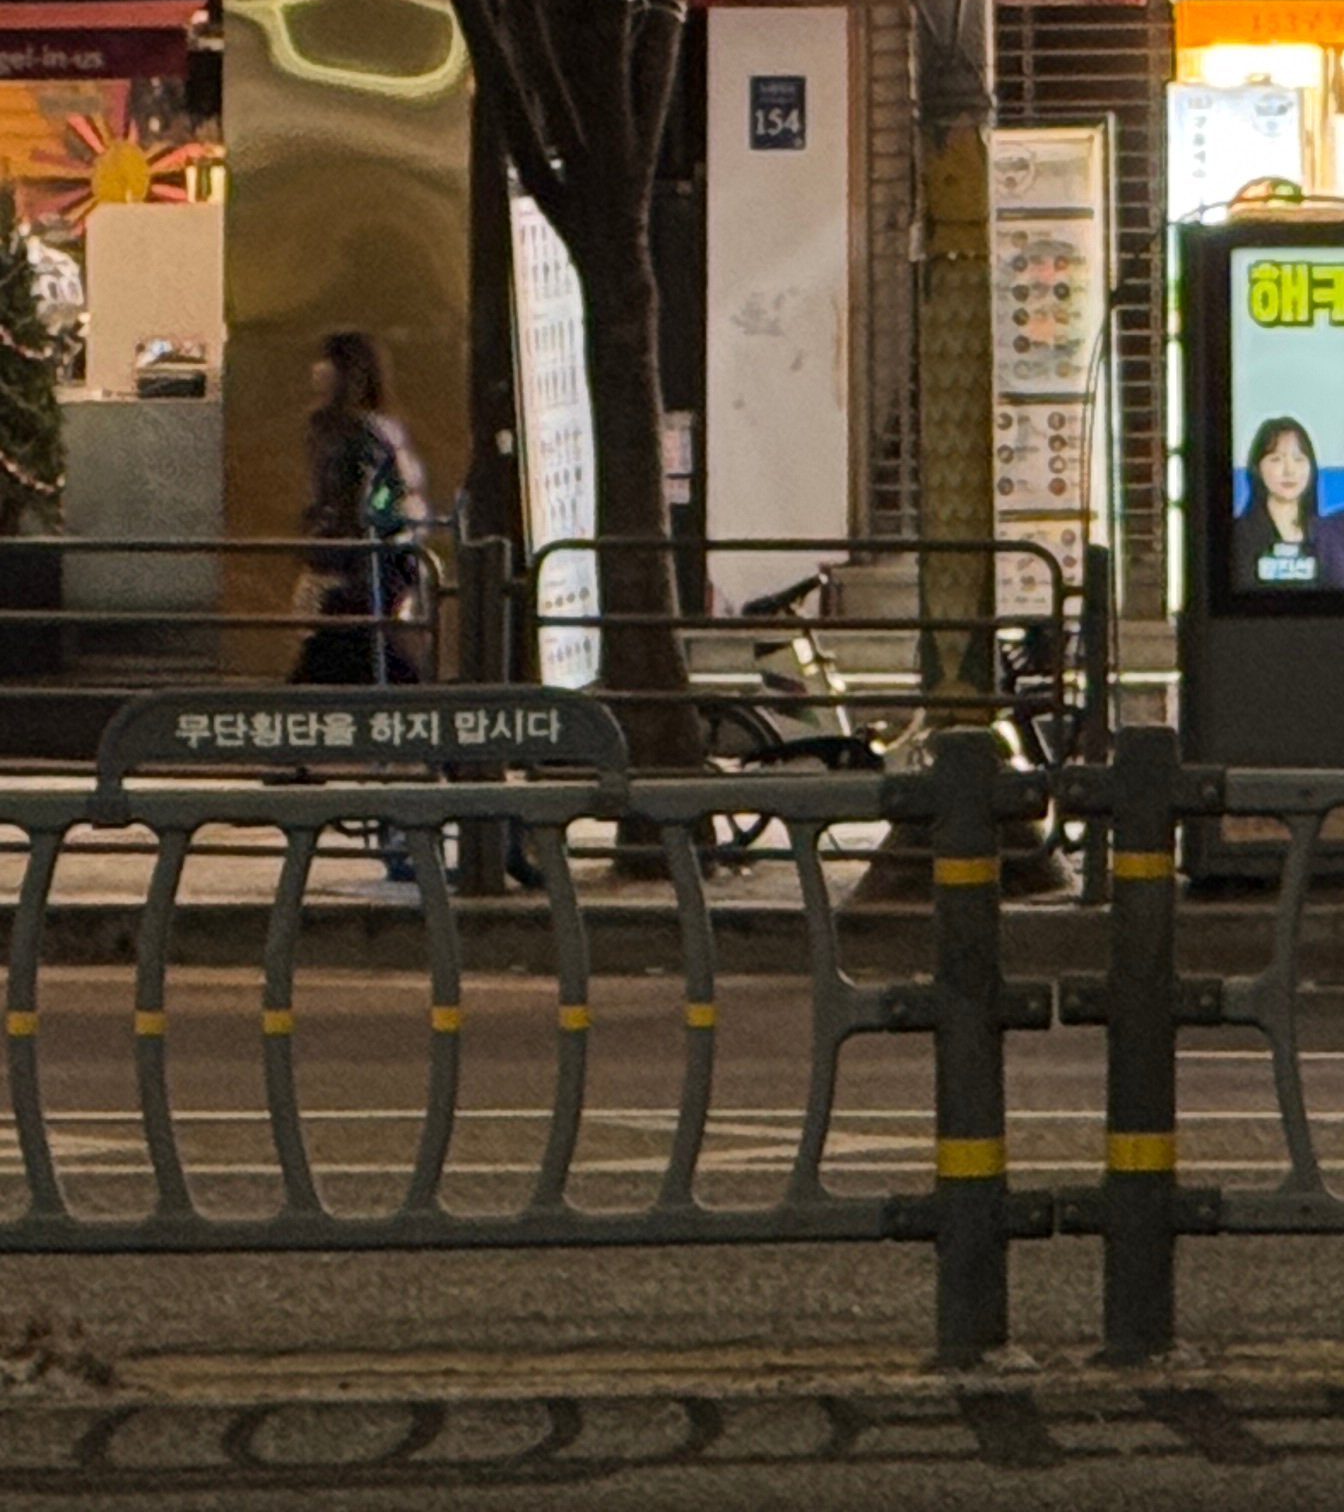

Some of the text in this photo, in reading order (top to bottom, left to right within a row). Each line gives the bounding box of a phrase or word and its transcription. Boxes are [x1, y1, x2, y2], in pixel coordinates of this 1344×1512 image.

[754, 107, 801, 138] 154
[174, 710, 357, 748] 무단횡단을
[369, 711, 441, 746] 하지
